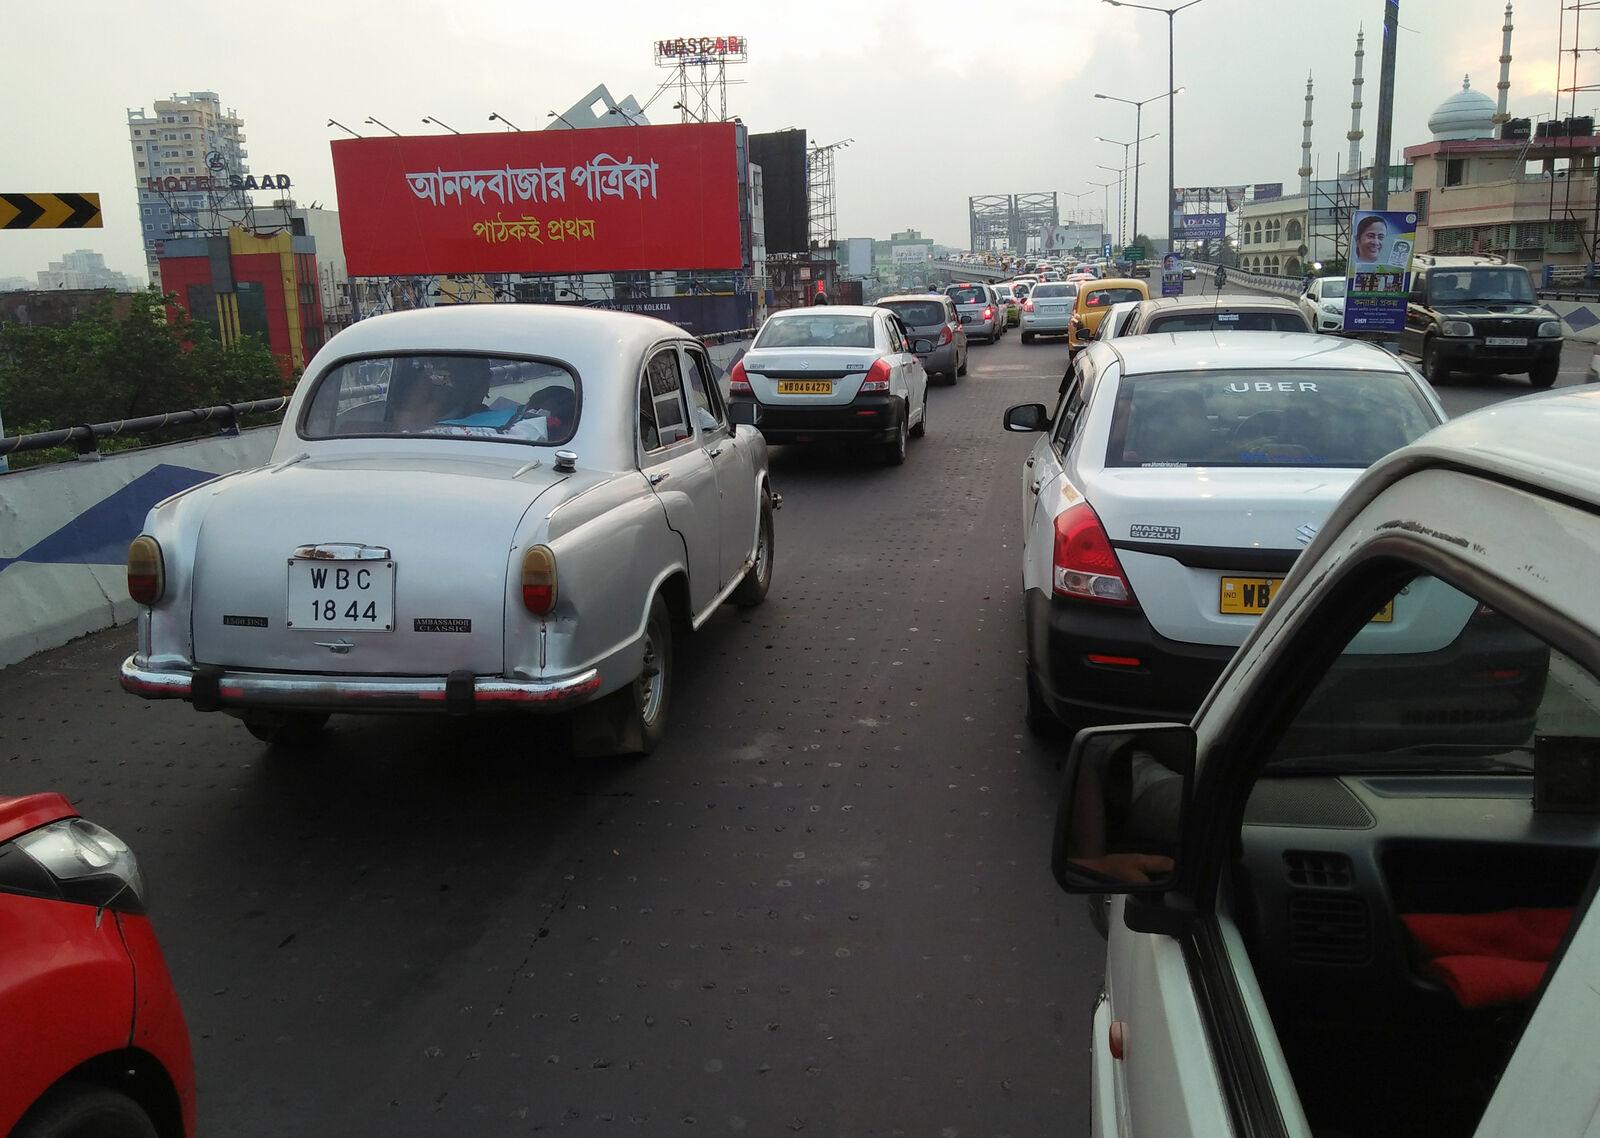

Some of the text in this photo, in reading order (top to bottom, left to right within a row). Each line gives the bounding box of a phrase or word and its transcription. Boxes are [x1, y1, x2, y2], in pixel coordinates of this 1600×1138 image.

[147, 174, 291, 193] HOTEL SAAD
[405, 152, 659, 207] আনন্দবাজার পত্রিকা
[472, 212, 596, 245] পাঠকই প্রথম
[643, 303, 671, 312] KOLKATA
[1231, 382, 1318, 393] UBER
[1131, 525, 1180, 534] MARUTI
[1131, 531, 1179, 540] SUZUKI
[310, 568, 372, 590] WBC
[1223, 591, 1237, 599] IND
[416, 619, 470, 627] AMBASSADOR
